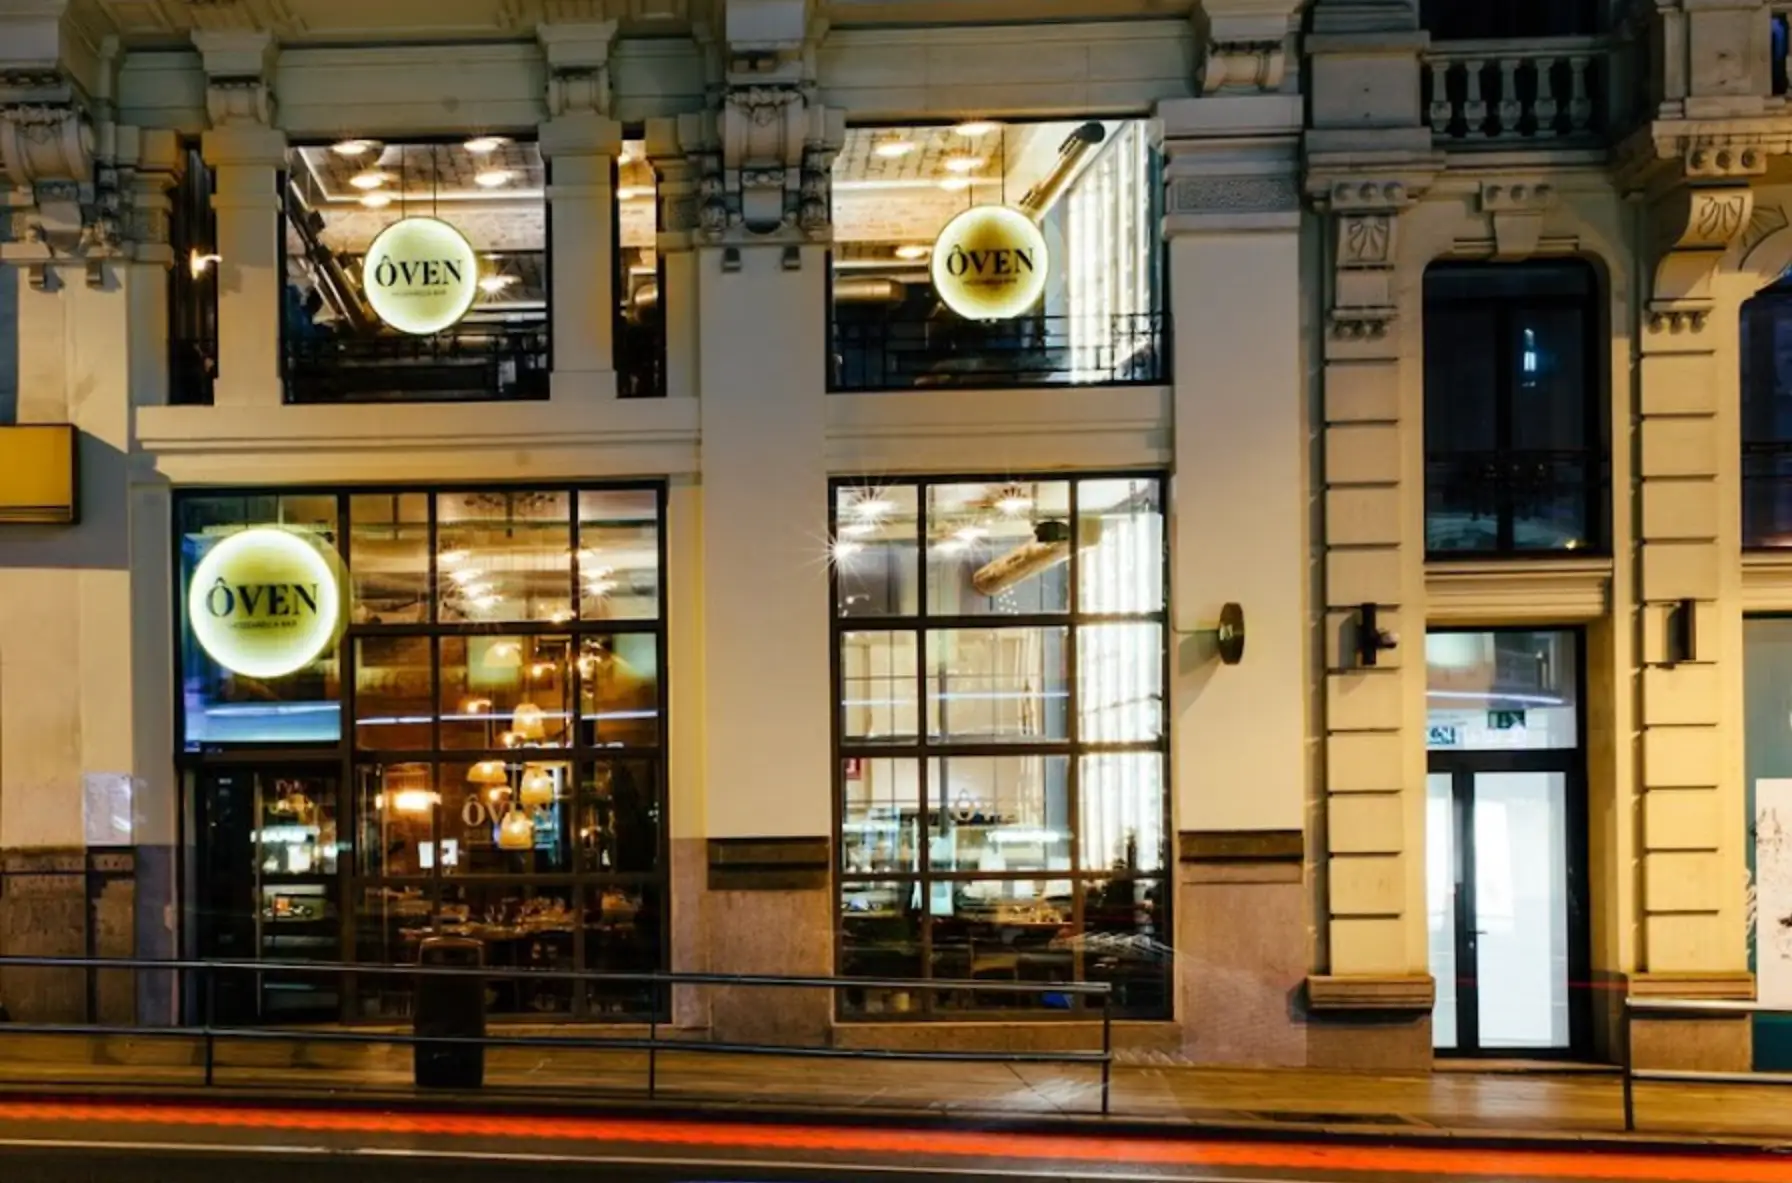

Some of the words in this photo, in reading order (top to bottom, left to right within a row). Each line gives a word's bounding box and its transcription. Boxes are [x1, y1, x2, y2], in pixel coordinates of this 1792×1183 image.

[375, 254, 463, 287] ÔVEN
[946, 244, 1034, 276] ÔVEN
[205, 576, 319, 618] ÔVEN
